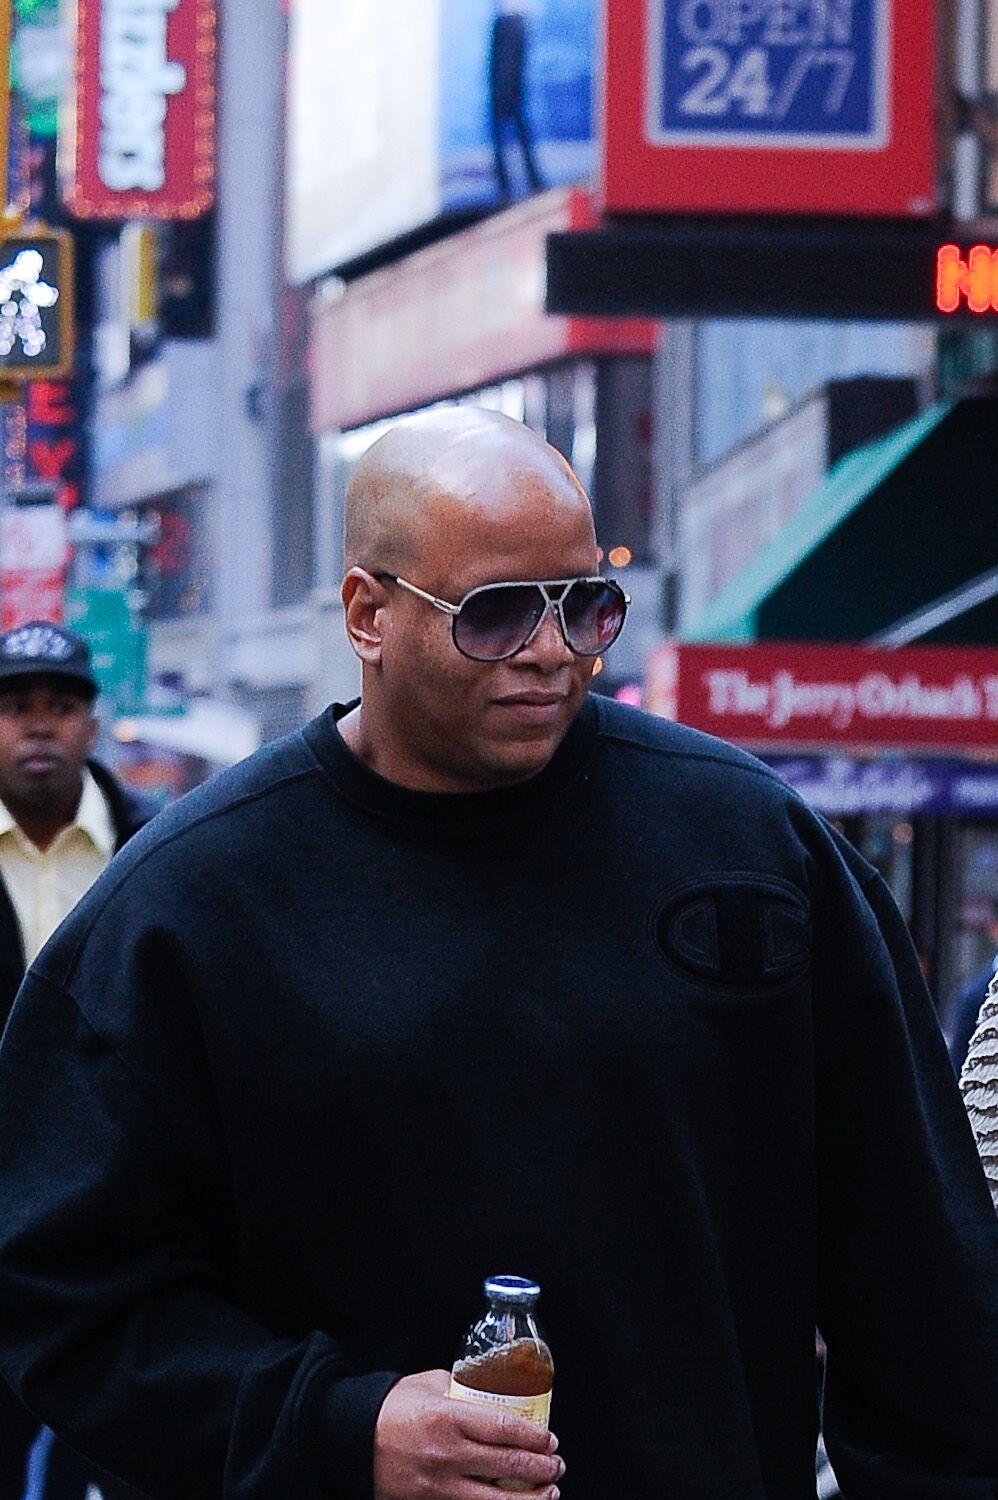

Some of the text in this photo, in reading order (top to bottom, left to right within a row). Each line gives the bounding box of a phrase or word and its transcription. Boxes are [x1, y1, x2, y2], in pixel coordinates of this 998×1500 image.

[677, 47, 856, 121] 24/7
[708, 669, 769, 716] The
[766, 669, 854, 730] Jerry
[857, 671, 980, 719] Orbach
